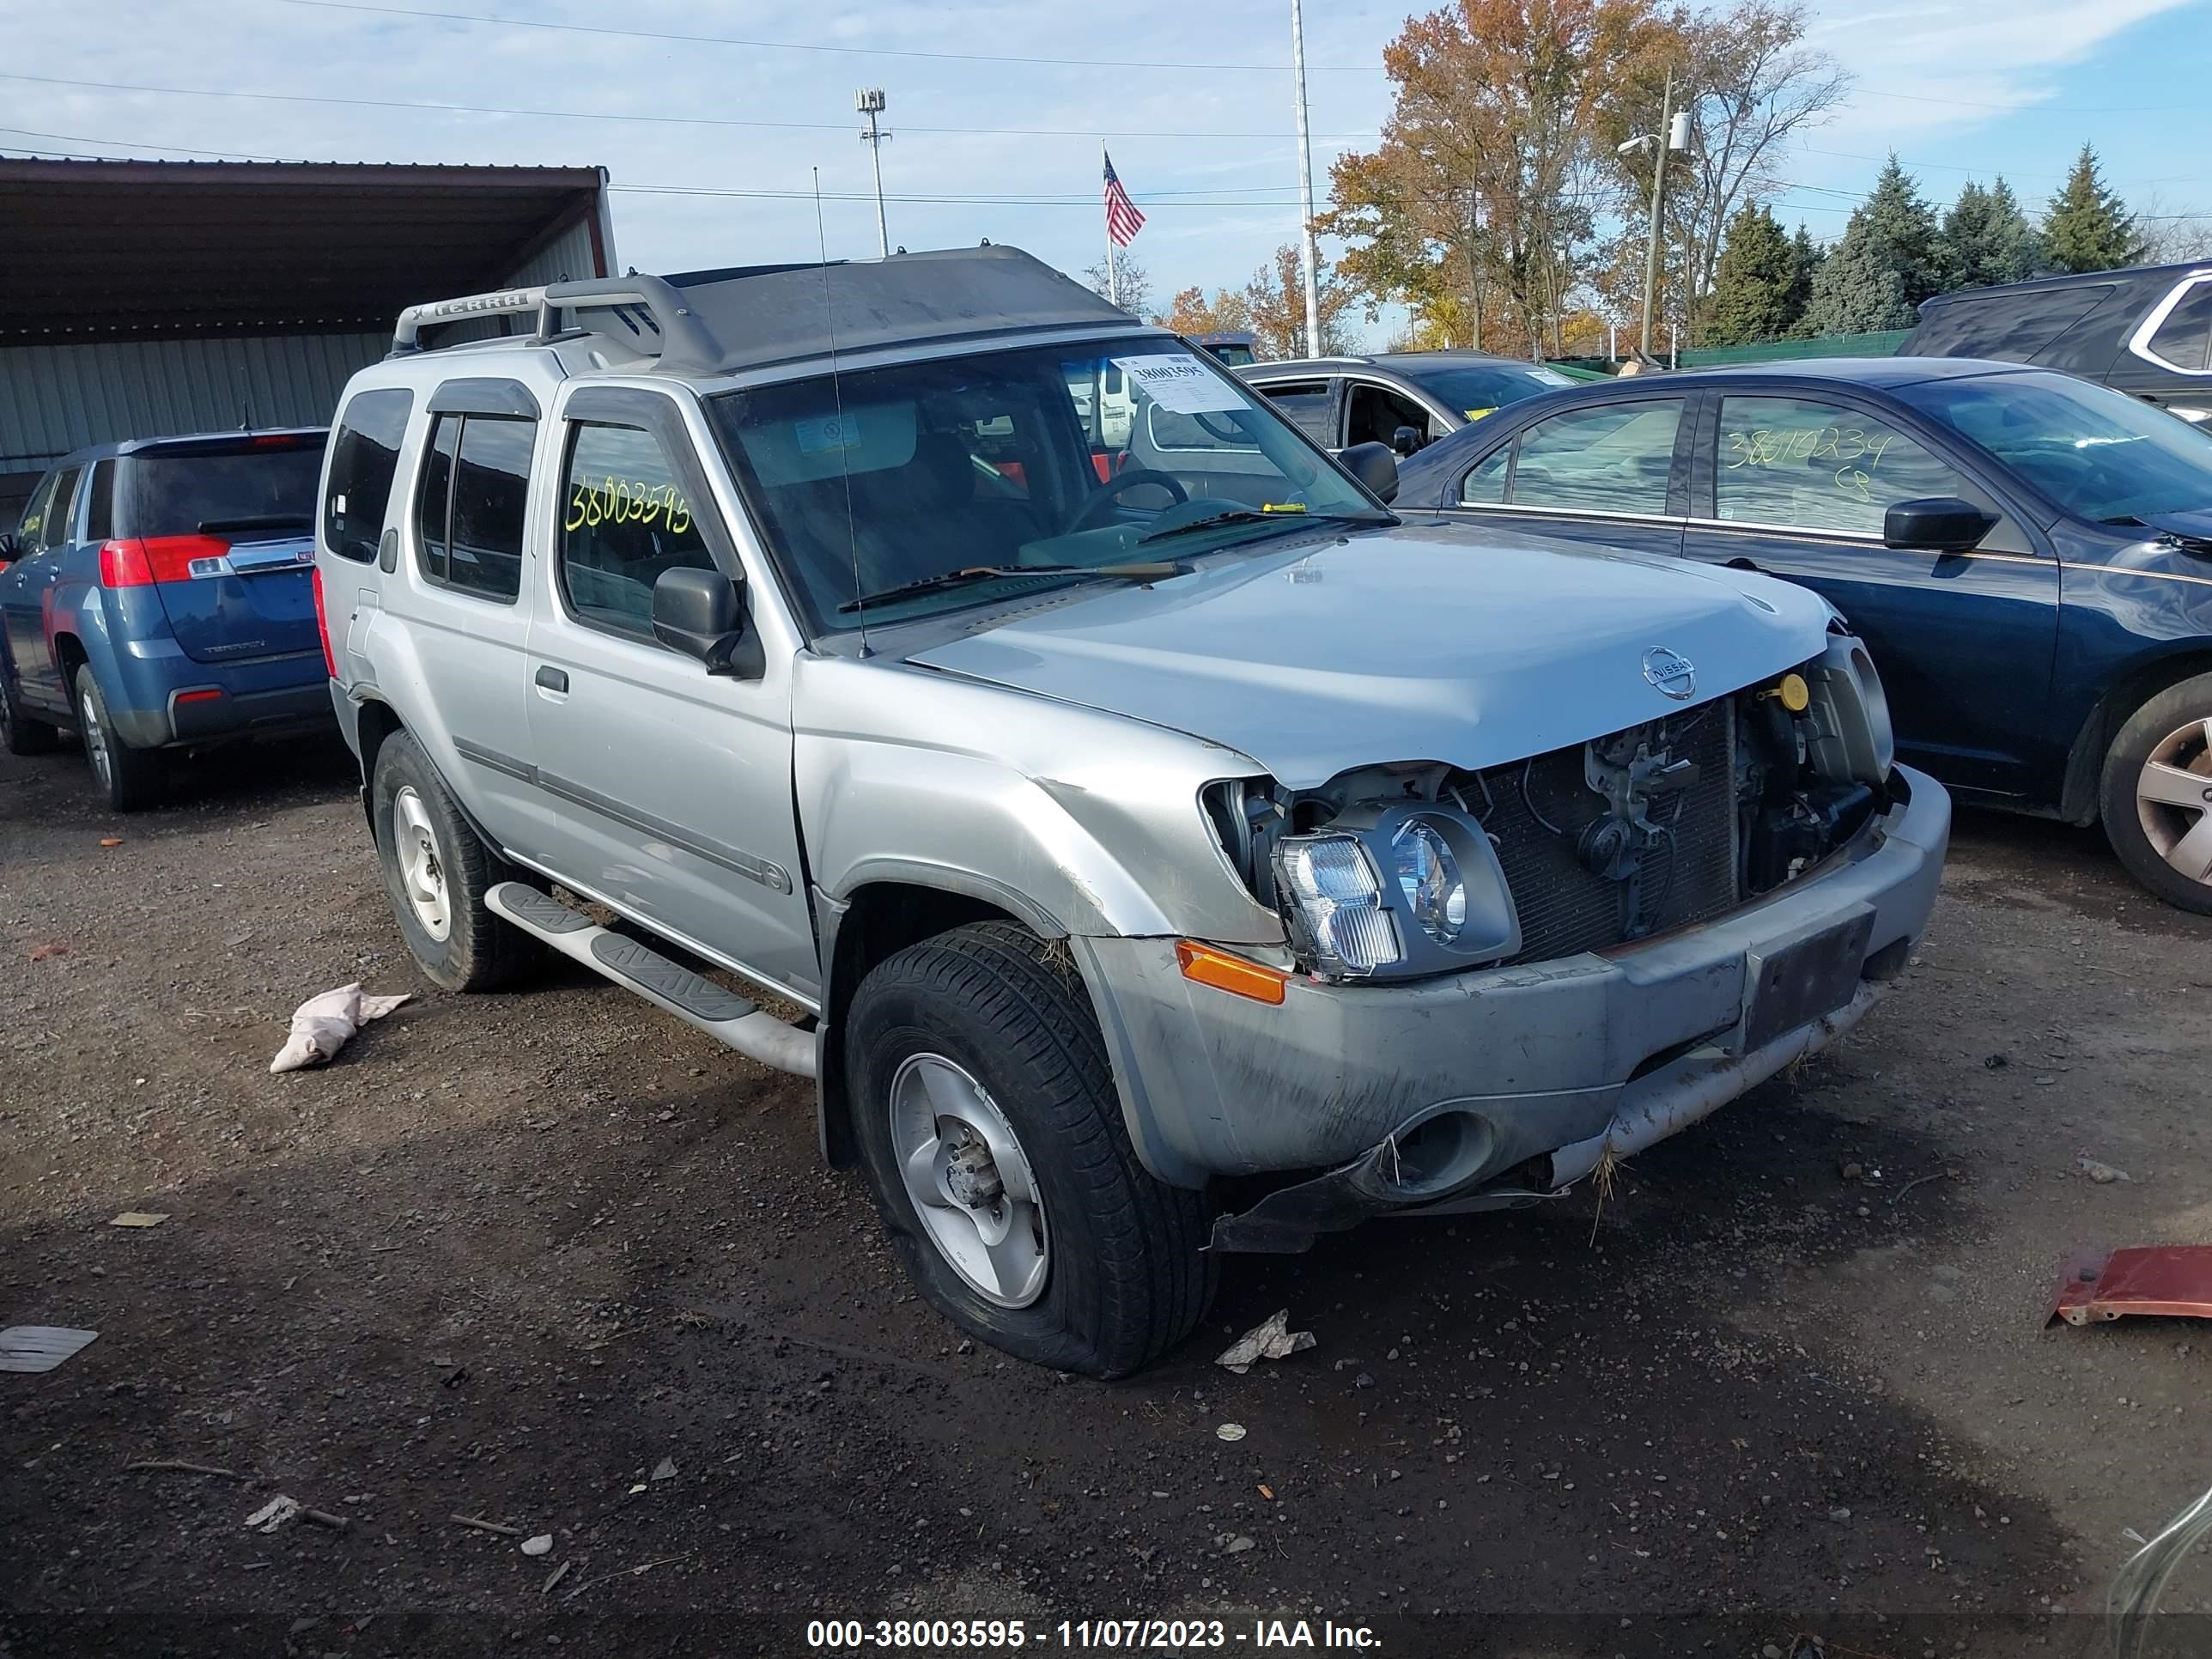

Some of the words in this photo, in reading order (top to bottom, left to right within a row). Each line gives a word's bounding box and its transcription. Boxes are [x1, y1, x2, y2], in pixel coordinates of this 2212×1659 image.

[1133, 366, 1205, 381] 38003595
[1727, 428, 1893, 471] 38010234
[565, 473, 690, 533] 38003595
[1652, 659, 1692, 680] NISSAN
